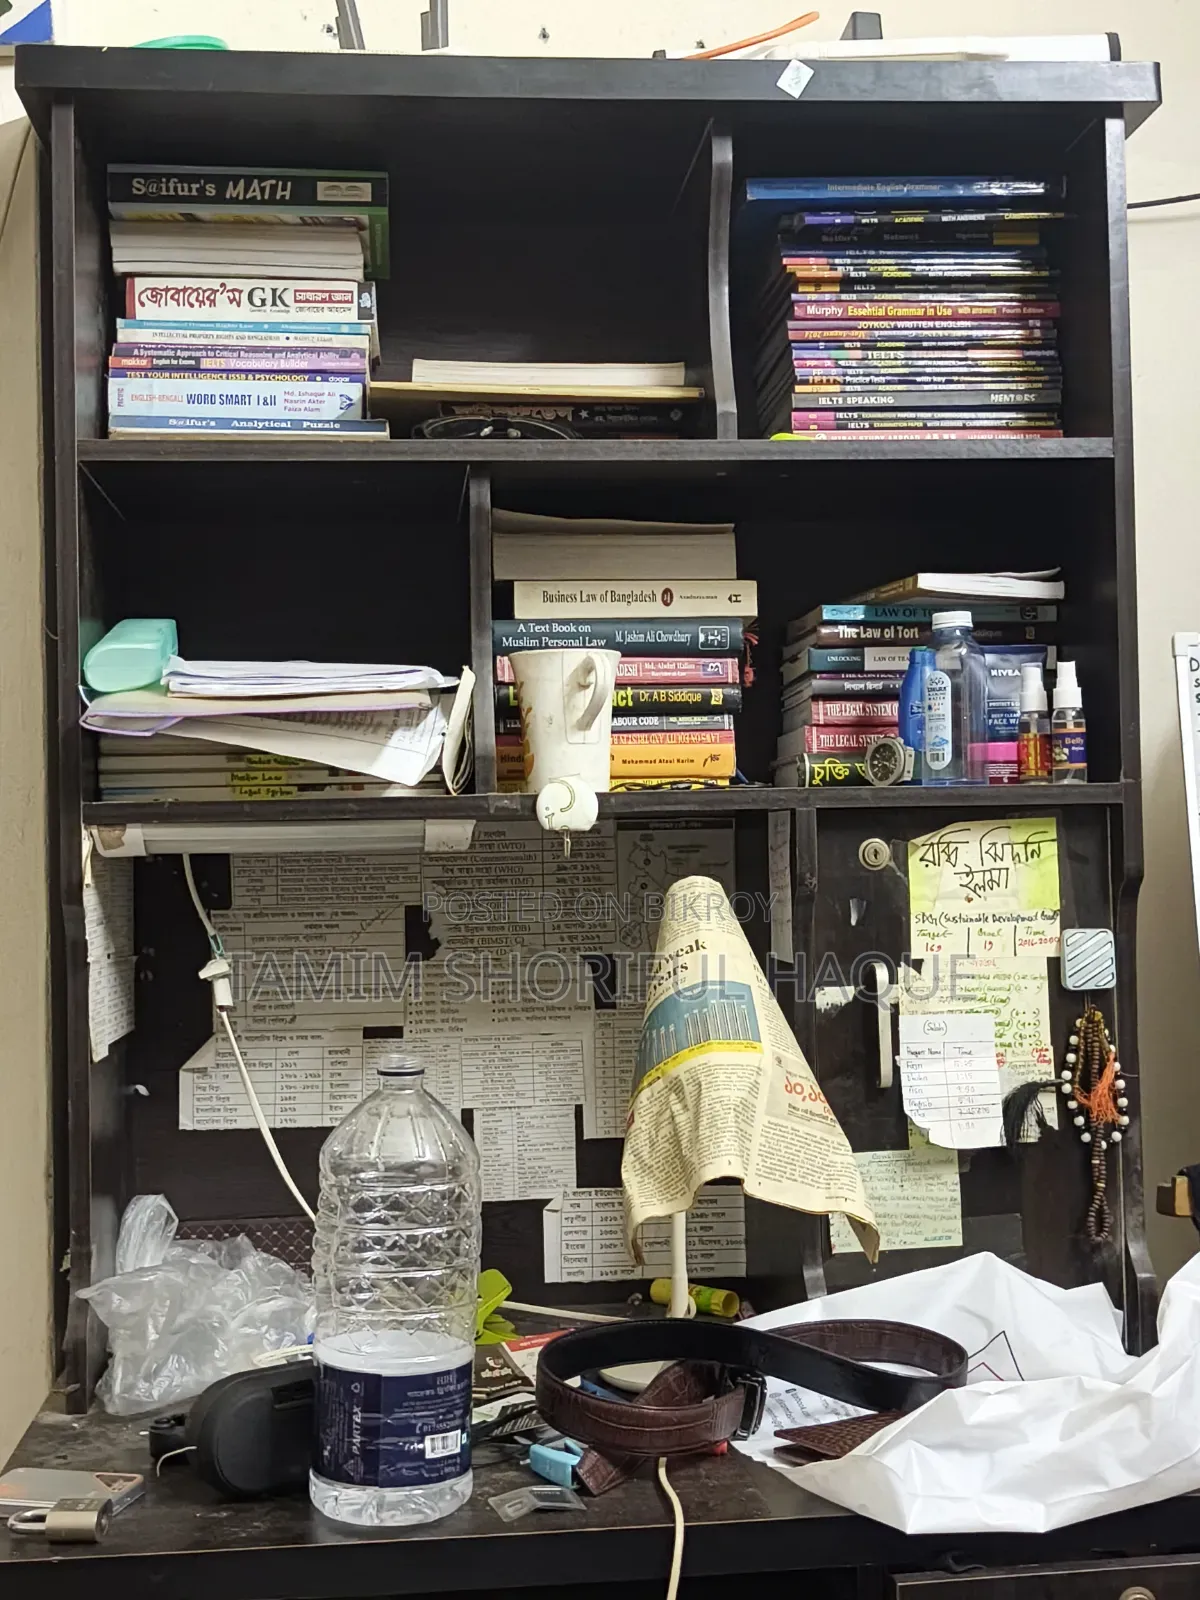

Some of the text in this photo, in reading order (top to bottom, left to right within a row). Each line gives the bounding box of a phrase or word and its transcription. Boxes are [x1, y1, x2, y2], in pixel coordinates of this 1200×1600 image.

[131, 178, 292, 200] S@ifur's MATH
[827, 184, 875, 192] Intermediate
[876, 184, 905, 192] English
[247, 286, 291, 308] GK
[806, 305, 843, 316] Murphy
[847, 305, 886, 316] Essential
[887, 306, 925, 316] Grammar
[926, 305, 935, 316] in
[936, 306, 953, 316] Use
[139, 349, 176, 358] Systematic
[176, 350, 206, 358] Approach
[215, 350, 239, 358] Critical
[203, 358, 226, 367] IELTS
[229, 358, 279, 368] Vocabulary
[280, 359, 309, 368] Builder
[171, 372, 228, 380] INTELLIGENCE
[254, 374, 309, 382] PSYCHOLOGY
[186, 393, 216, 405] WORD
[218, 394, 252, 406] SMART
[818, 396, 895, 405] IELTS SPEAKING
[231, 420, 341, 429] Analytical Puzzle
[542, 590, 657, 606] Business Law of Bangladesh
[874, 607, 916, 618] LAW OF
[517, 622, 592, 633] A Text Book on
[838, 625, 919, 639] The Law of Tort
[502, 636, 607, 647] Muslim Personal Law
[624, 630, 645, 645] Jashim
[645, 630, 655, 643] Ali
[656, 630, 692, 646] Chowdhury
[990, 669, 1020, 677] NIVEA
[640, 690, 702, 704] Dr. A B Siddique
[826, 703, 888, 717] THE LEGAL SYSTEM
[611, 716, 638, 726] ABOUR
[639, 716, 659, 726] CODE
[820, 734, 859, 747] THE LEGAL
[1064, 737, 1085, 747] Belly
[811, 757, 852, 787] চুক্তি
[497, 842, 526, 850] (WTO)
[494, 865, 524, 875] (WHO)
[510, 877, 534, 886] (IMF)
[954, 864, 1009, 898] ইলমা
[915, 912, 937, 926] SDG
[507, 925, 531, 933] (IDB)
[664, 938, 707, 965] weak
[925, 942, 942, 953] 169
[352, 1405, 362, 1456] PARTEX
